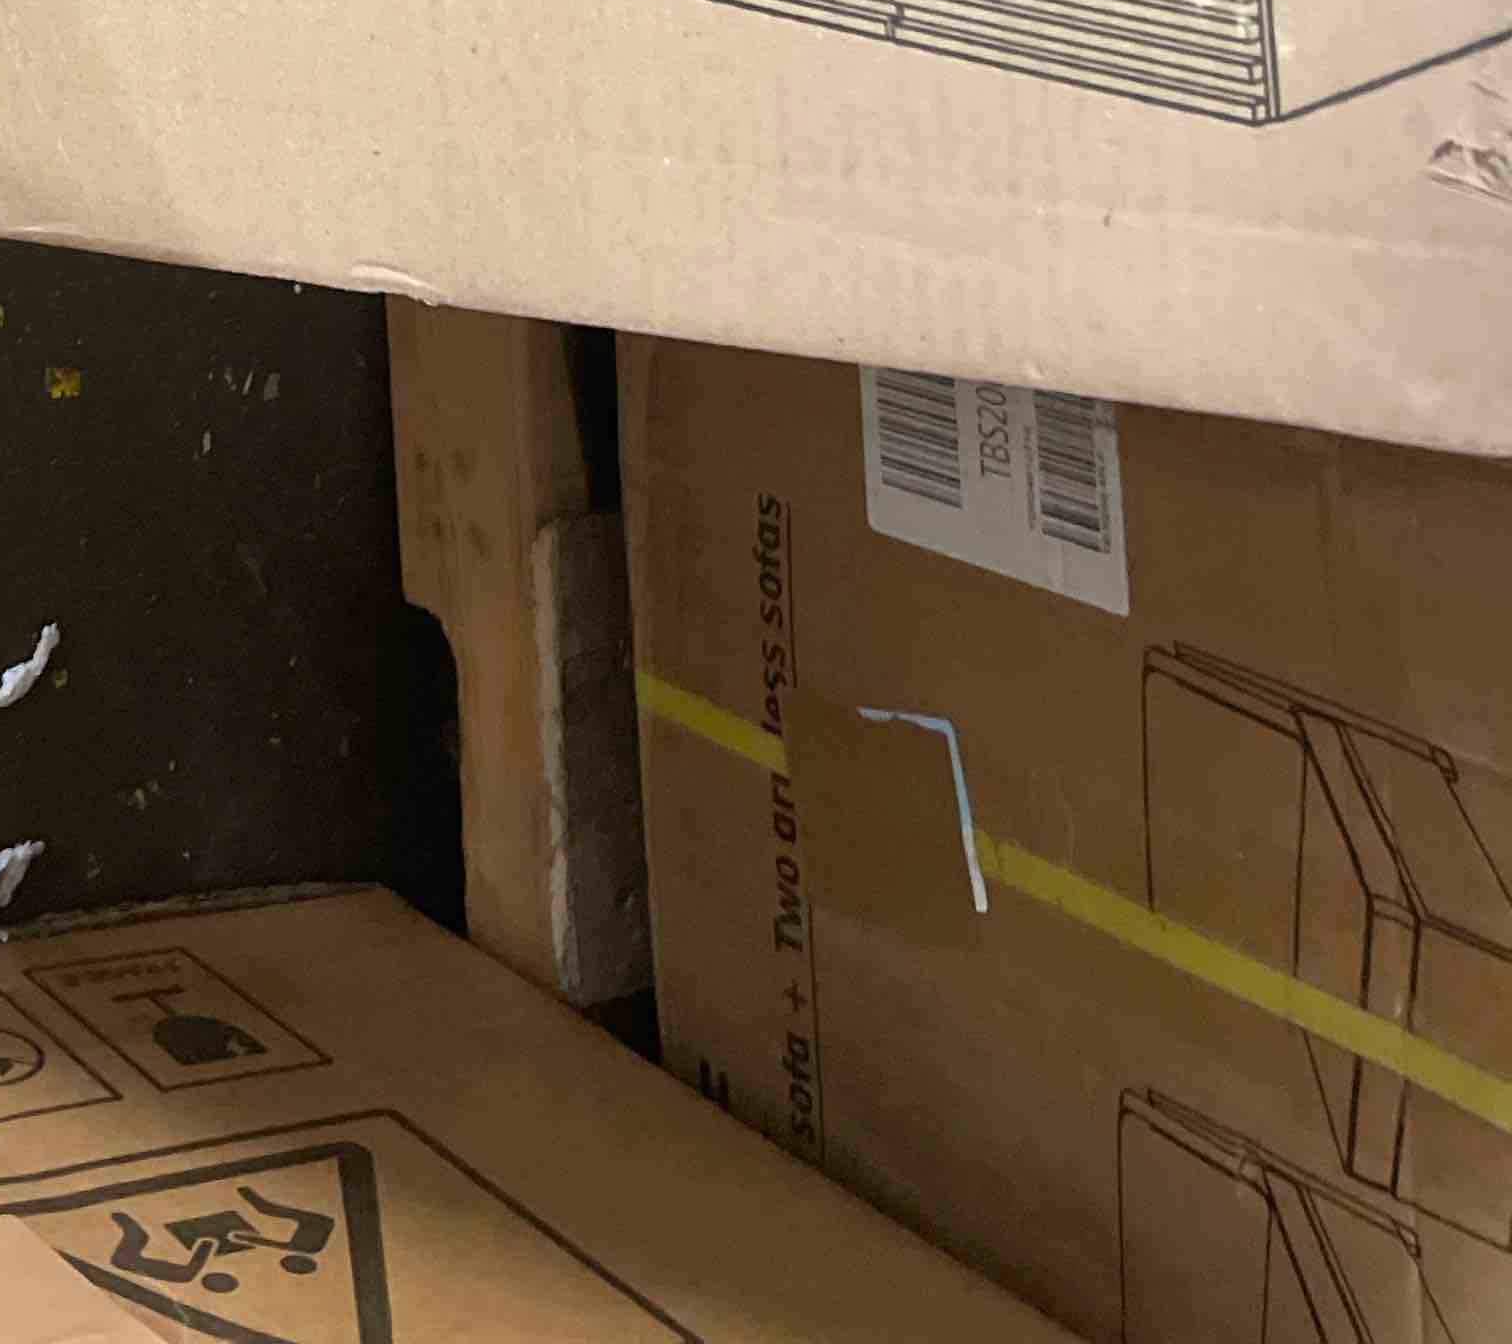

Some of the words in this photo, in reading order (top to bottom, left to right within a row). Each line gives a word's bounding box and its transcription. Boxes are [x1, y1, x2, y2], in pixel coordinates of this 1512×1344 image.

[975, 383, 1012, 479] TBS20
[752, 492, 782, 629] sofas
[774, 855, 803, 953] Two
